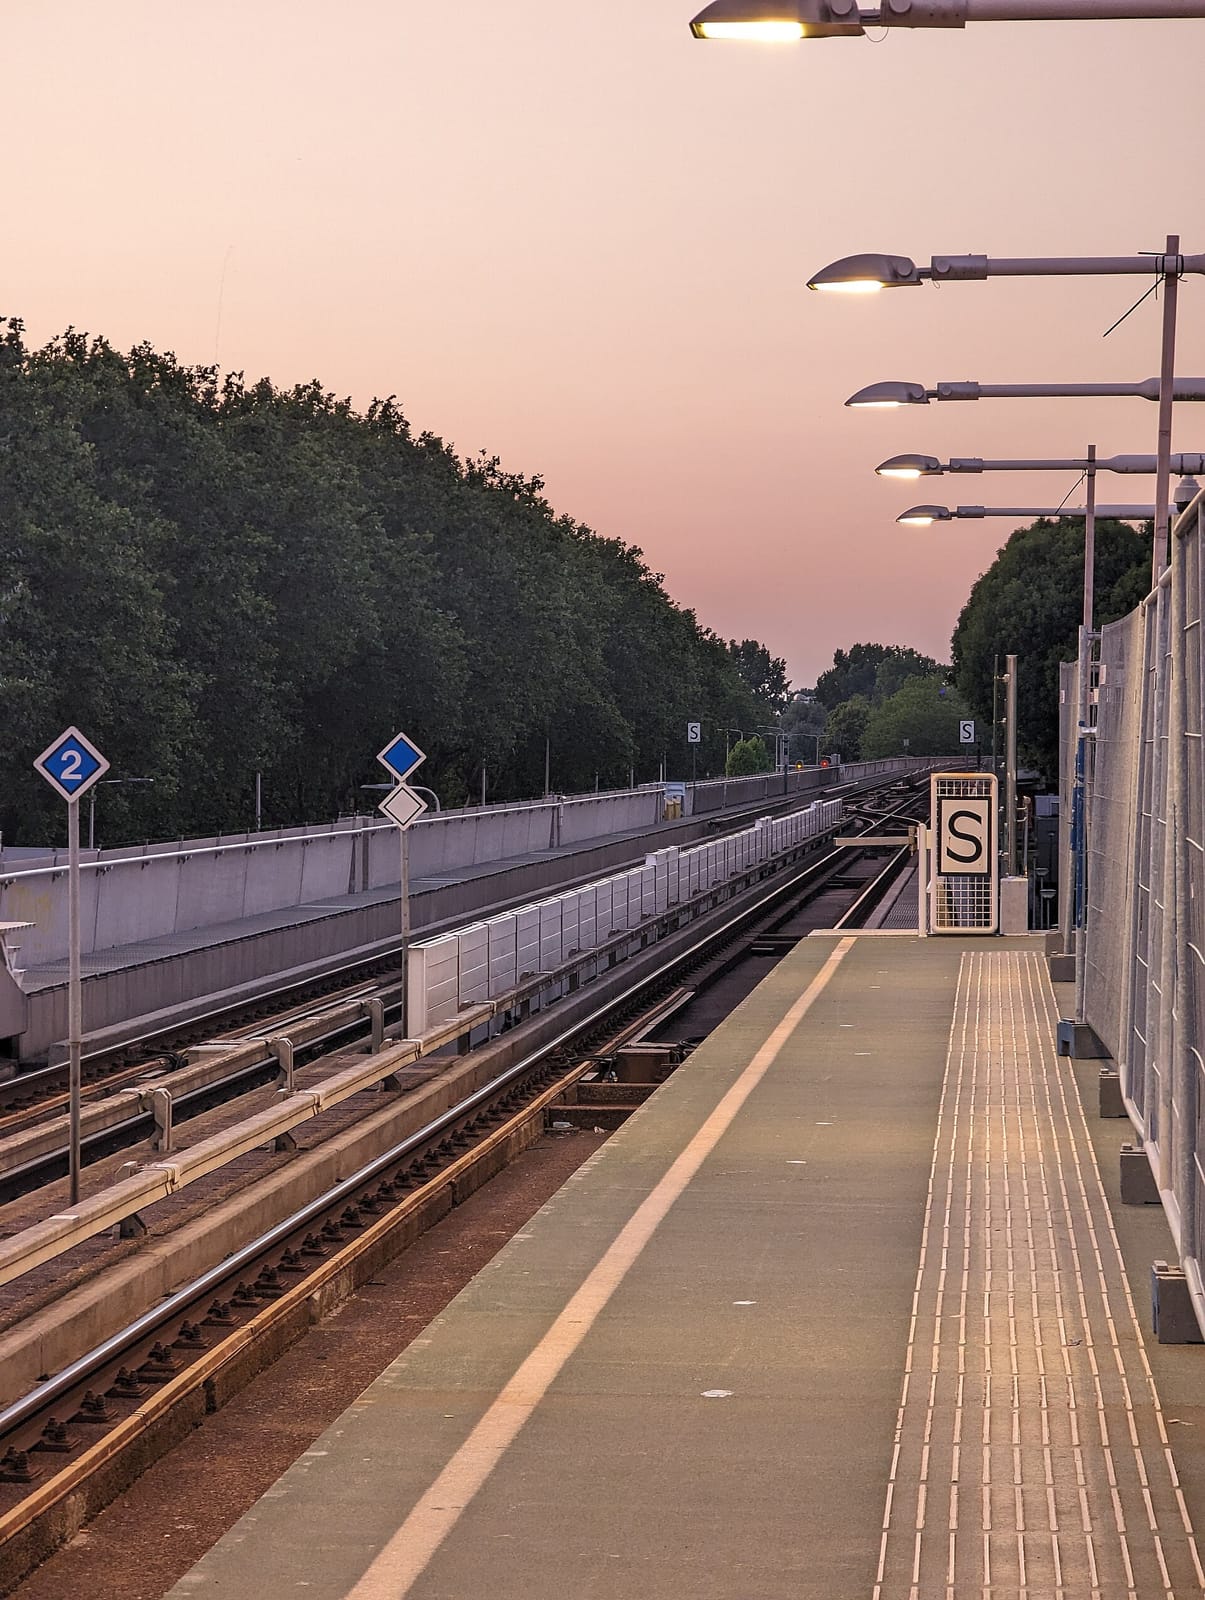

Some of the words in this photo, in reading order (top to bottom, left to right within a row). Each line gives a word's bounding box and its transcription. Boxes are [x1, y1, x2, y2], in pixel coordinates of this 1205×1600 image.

[690, 726, 698, 739] S
[963, 724, 972, 739] S
[60, 750, 82, 779] 2
[947, 810, 983, 863] S
